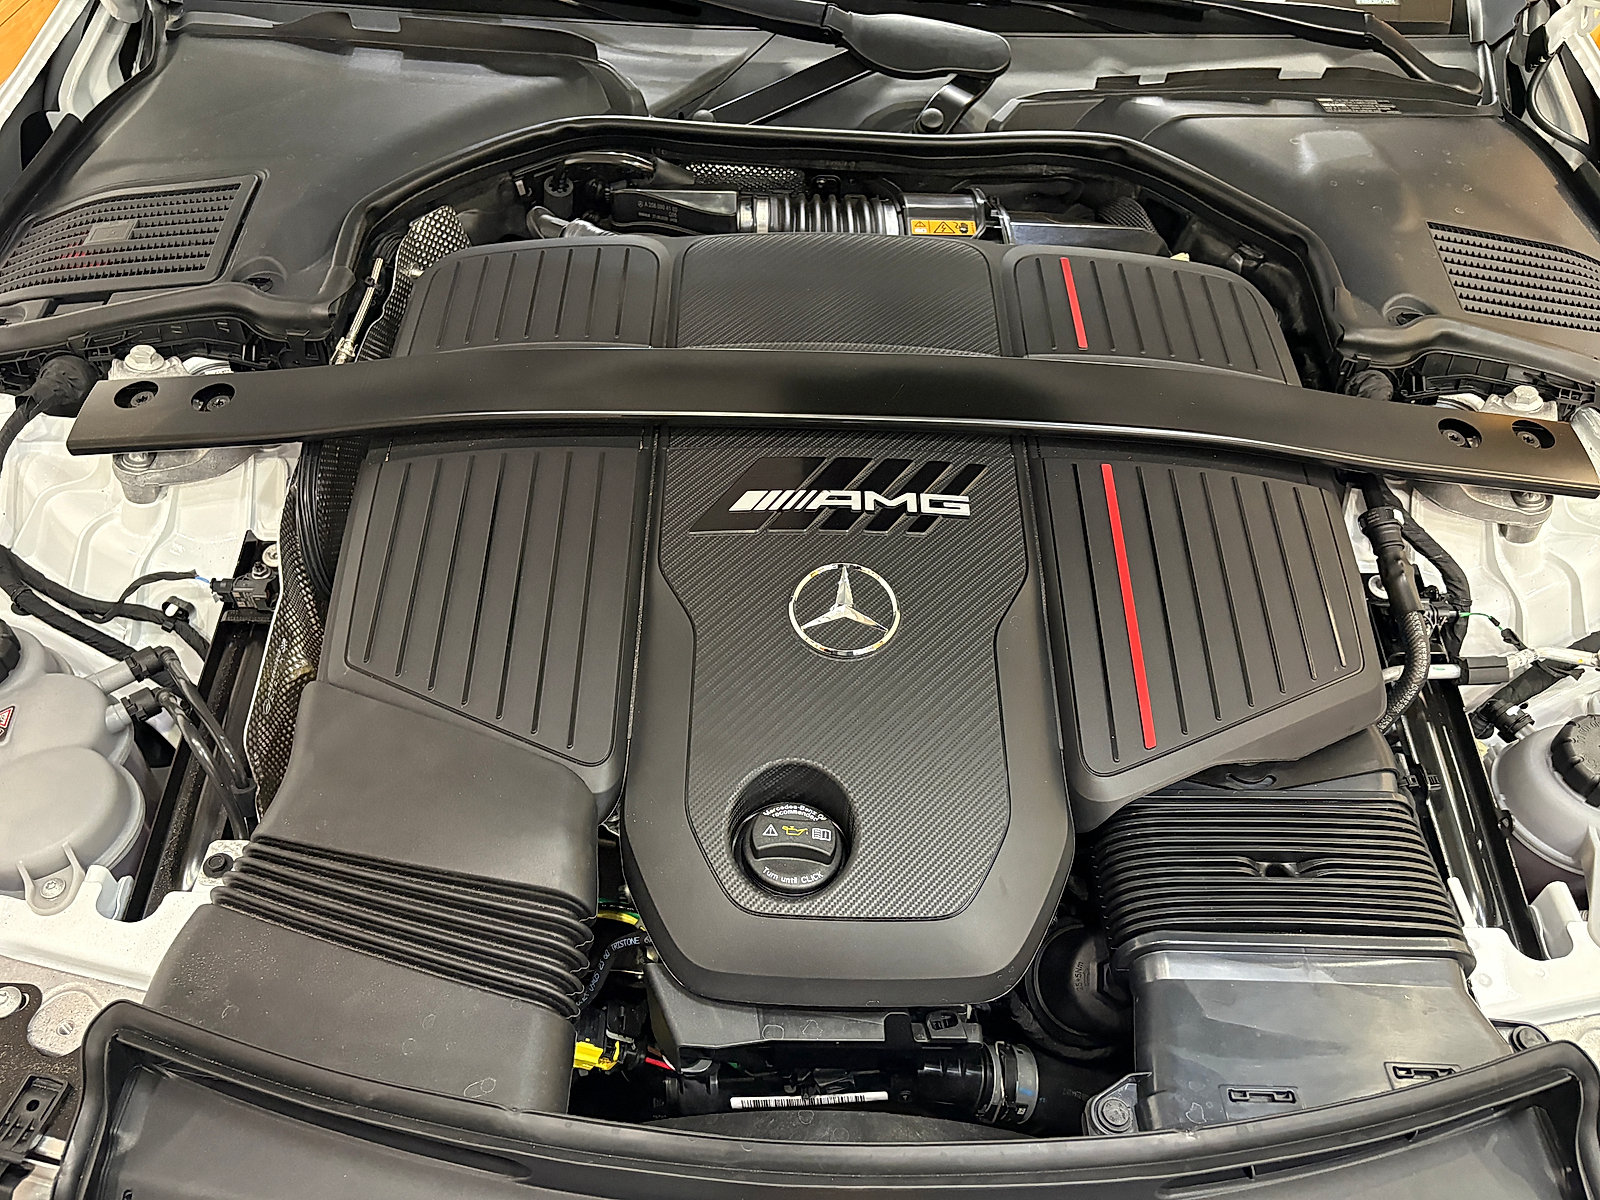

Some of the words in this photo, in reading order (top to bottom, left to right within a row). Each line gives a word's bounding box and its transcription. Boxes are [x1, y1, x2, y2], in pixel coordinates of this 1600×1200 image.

[804, 489, 971, 516] AMG
[763, 804, 817, 816] Mercedes-Benz
[763, 866, 779, 880] Turn
[780, 876, 797, 884] until
[801, 870, 824, 884] CLICK
[610, 936, 640, 951] TRISTONE
